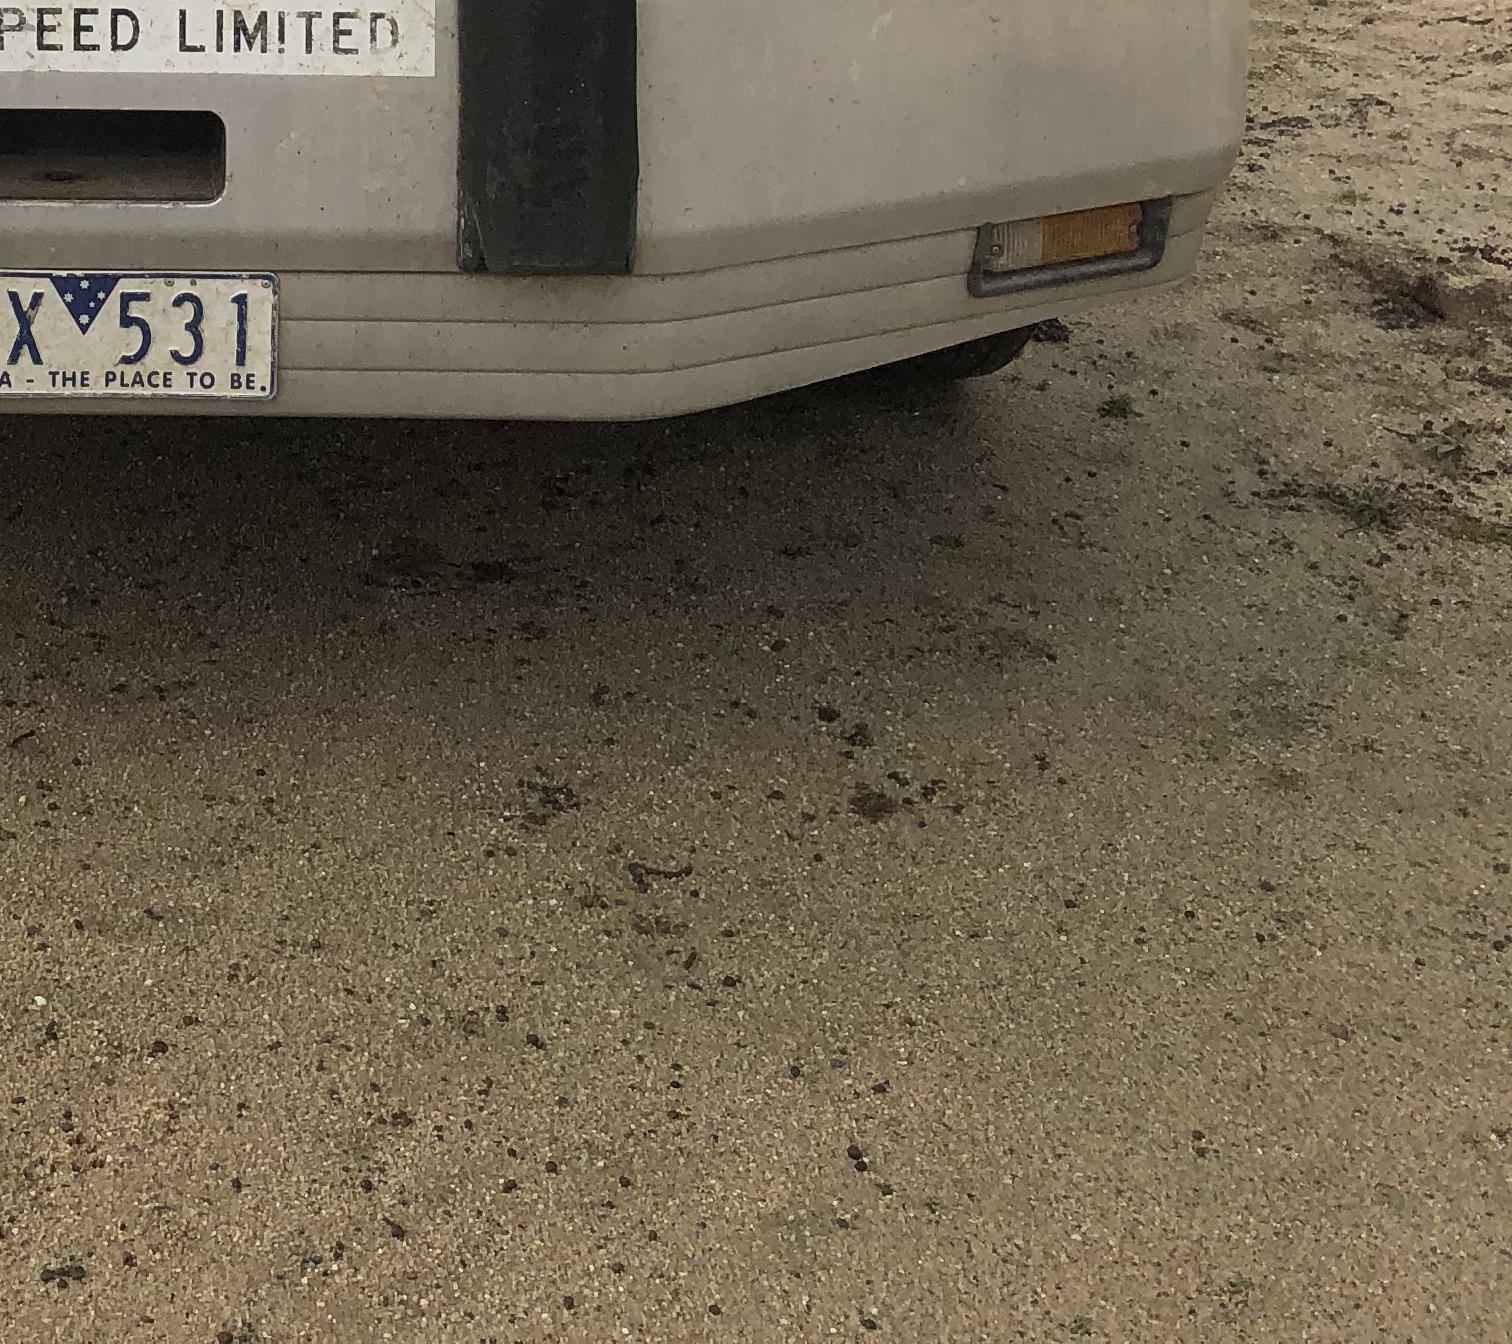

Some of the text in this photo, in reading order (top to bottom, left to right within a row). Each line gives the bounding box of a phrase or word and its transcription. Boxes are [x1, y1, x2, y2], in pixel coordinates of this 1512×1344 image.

[178, 8, 400, 56] LIMITED
[117, 290, 249, 367] 531
[48, 370, 90, 388] THE
[104, 371, 173, 389] PLACE
[187, 372, 216, 389] TO
